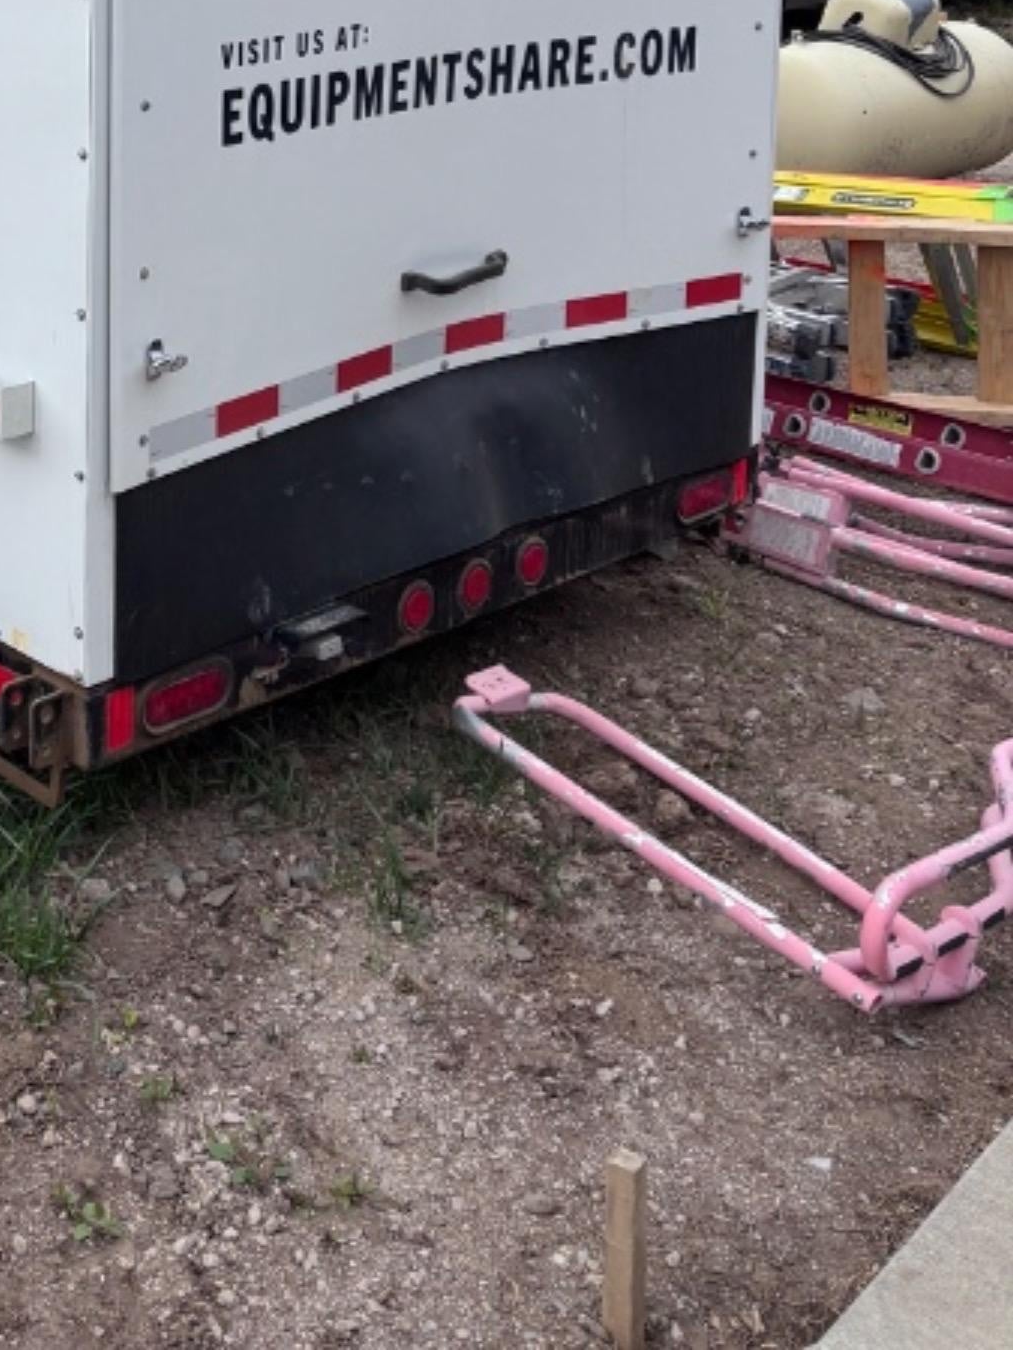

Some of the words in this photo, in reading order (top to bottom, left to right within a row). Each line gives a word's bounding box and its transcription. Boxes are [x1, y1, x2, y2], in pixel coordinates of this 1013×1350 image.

[221, 35, 285, 69] VISIT
[297, 29, 325, 58] US
[335, 23, 369, 51] AT:
[222, 26, 697, 147] EQUIPMENTSHARE.COM
